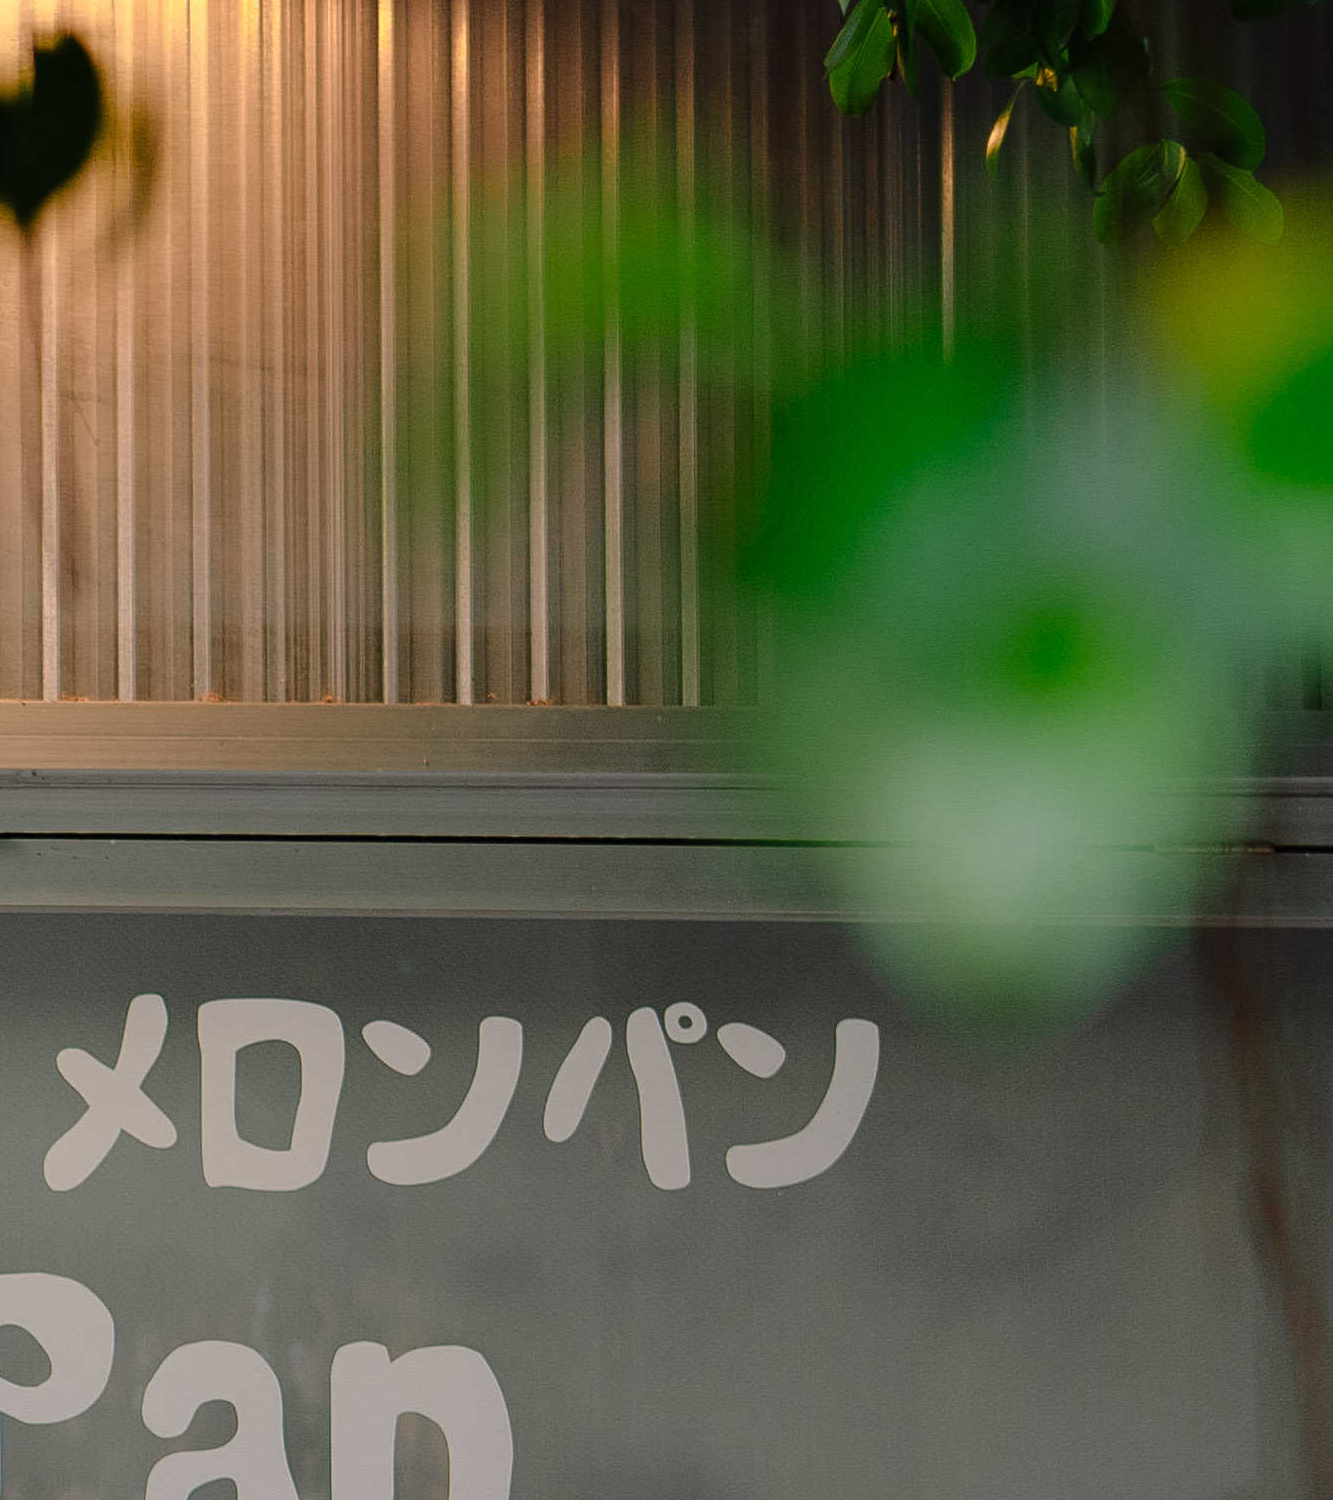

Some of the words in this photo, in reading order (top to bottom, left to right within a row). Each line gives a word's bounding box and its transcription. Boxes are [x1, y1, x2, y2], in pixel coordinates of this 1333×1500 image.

[42, 993, 881, 1193] メロンパン
